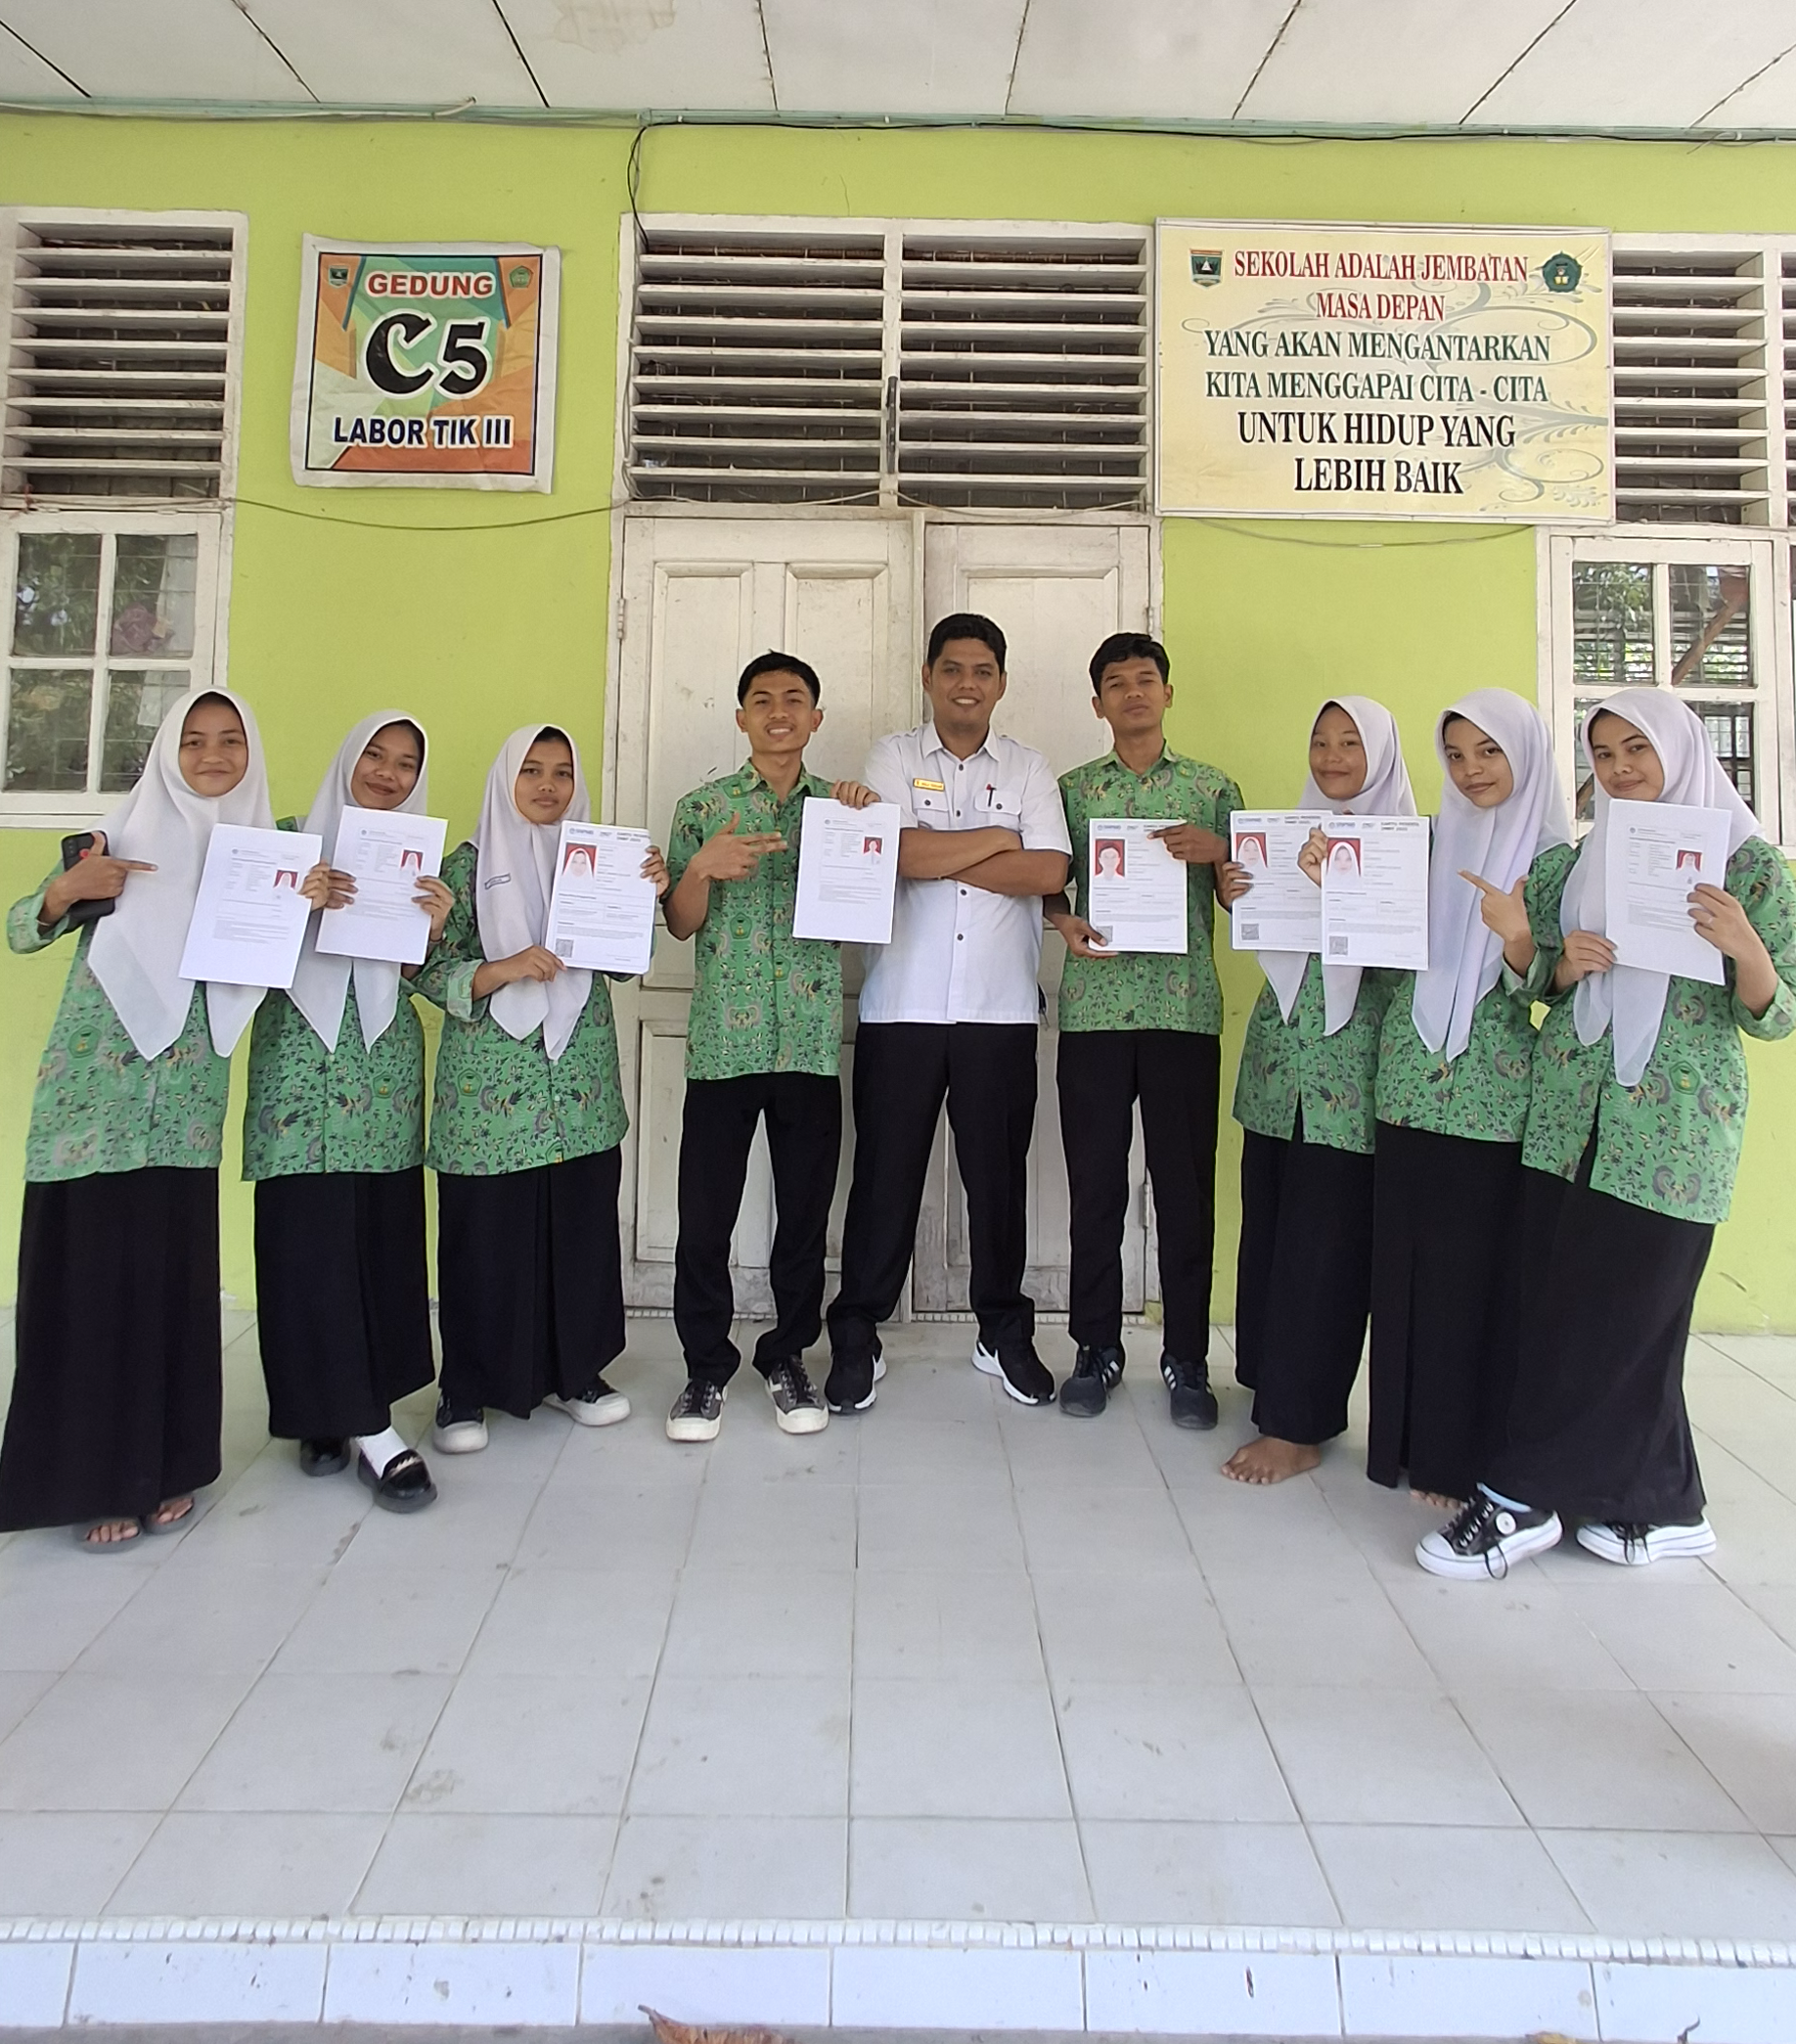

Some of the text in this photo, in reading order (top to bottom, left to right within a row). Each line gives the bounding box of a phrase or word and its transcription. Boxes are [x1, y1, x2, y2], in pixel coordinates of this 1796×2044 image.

[1235, 250, 1528, 282] SEKOLAH ADALAH JEMBATAN
[368, 274, 493, 295] GEDUNG
[1316, 293, 1445, 321] MASA DEPAN
[366, 313, 487, 394] C5
[1205, 330, 1550, 361] YANG AKAN MENGANTARKAN
[1205, 371, 1262, 398] KITA
[1267, 372, 1414, 400] MENGGAPAI
[1420, 375, 1474, 402] CITA
[1493, 375, 1549, 402] CITA
[334, 417, 512, 445] LABOR TIK III
[1237, 411, 1515, 447] UNTUK HIDUP YANG
[1294, 457, 1464, 494] LEBIH BAIK
